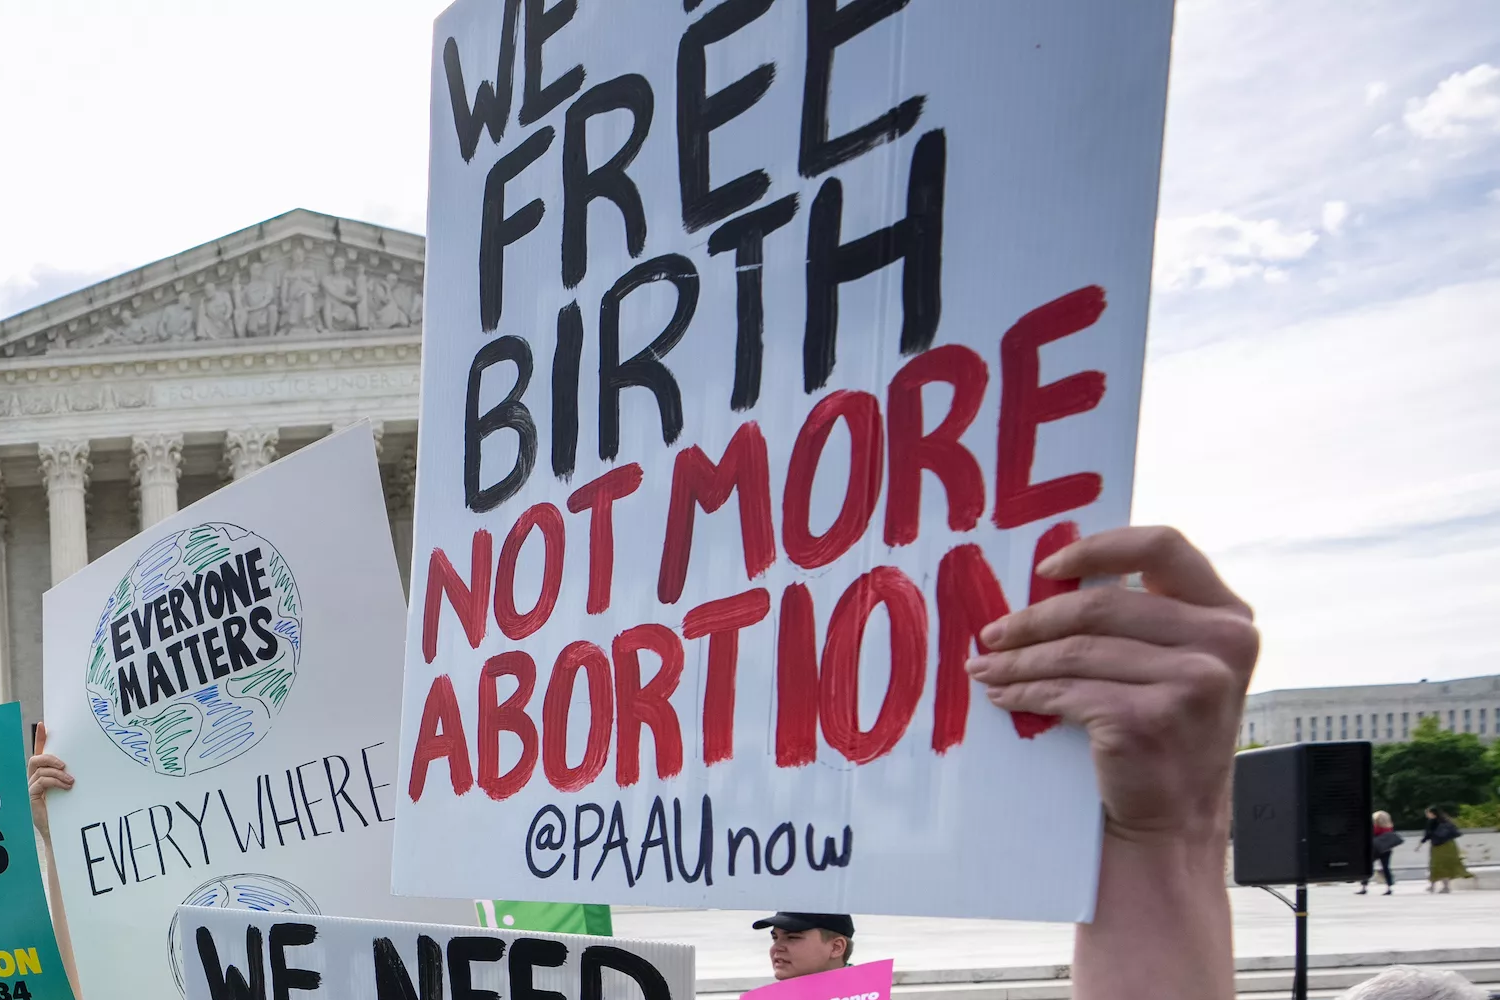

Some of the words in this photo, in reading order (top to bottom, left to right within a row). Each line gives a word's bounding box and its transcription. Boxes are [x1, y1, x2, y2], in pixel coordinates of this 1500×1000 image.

[443, 0, 585, 163] WE
[480, 0, 929, 333] FREE
[400, 372, 421, 388] LA
[464, 127, 947, 514] BIRTH
[422, 461, 643, 664] NOT
[657, 284, 1107, 604] MORE
[110, 546, 271, 662] EVERYONE
[117, 604, 279, 717] MATTERS
[408, 520, 1080, 803] ABORTION
